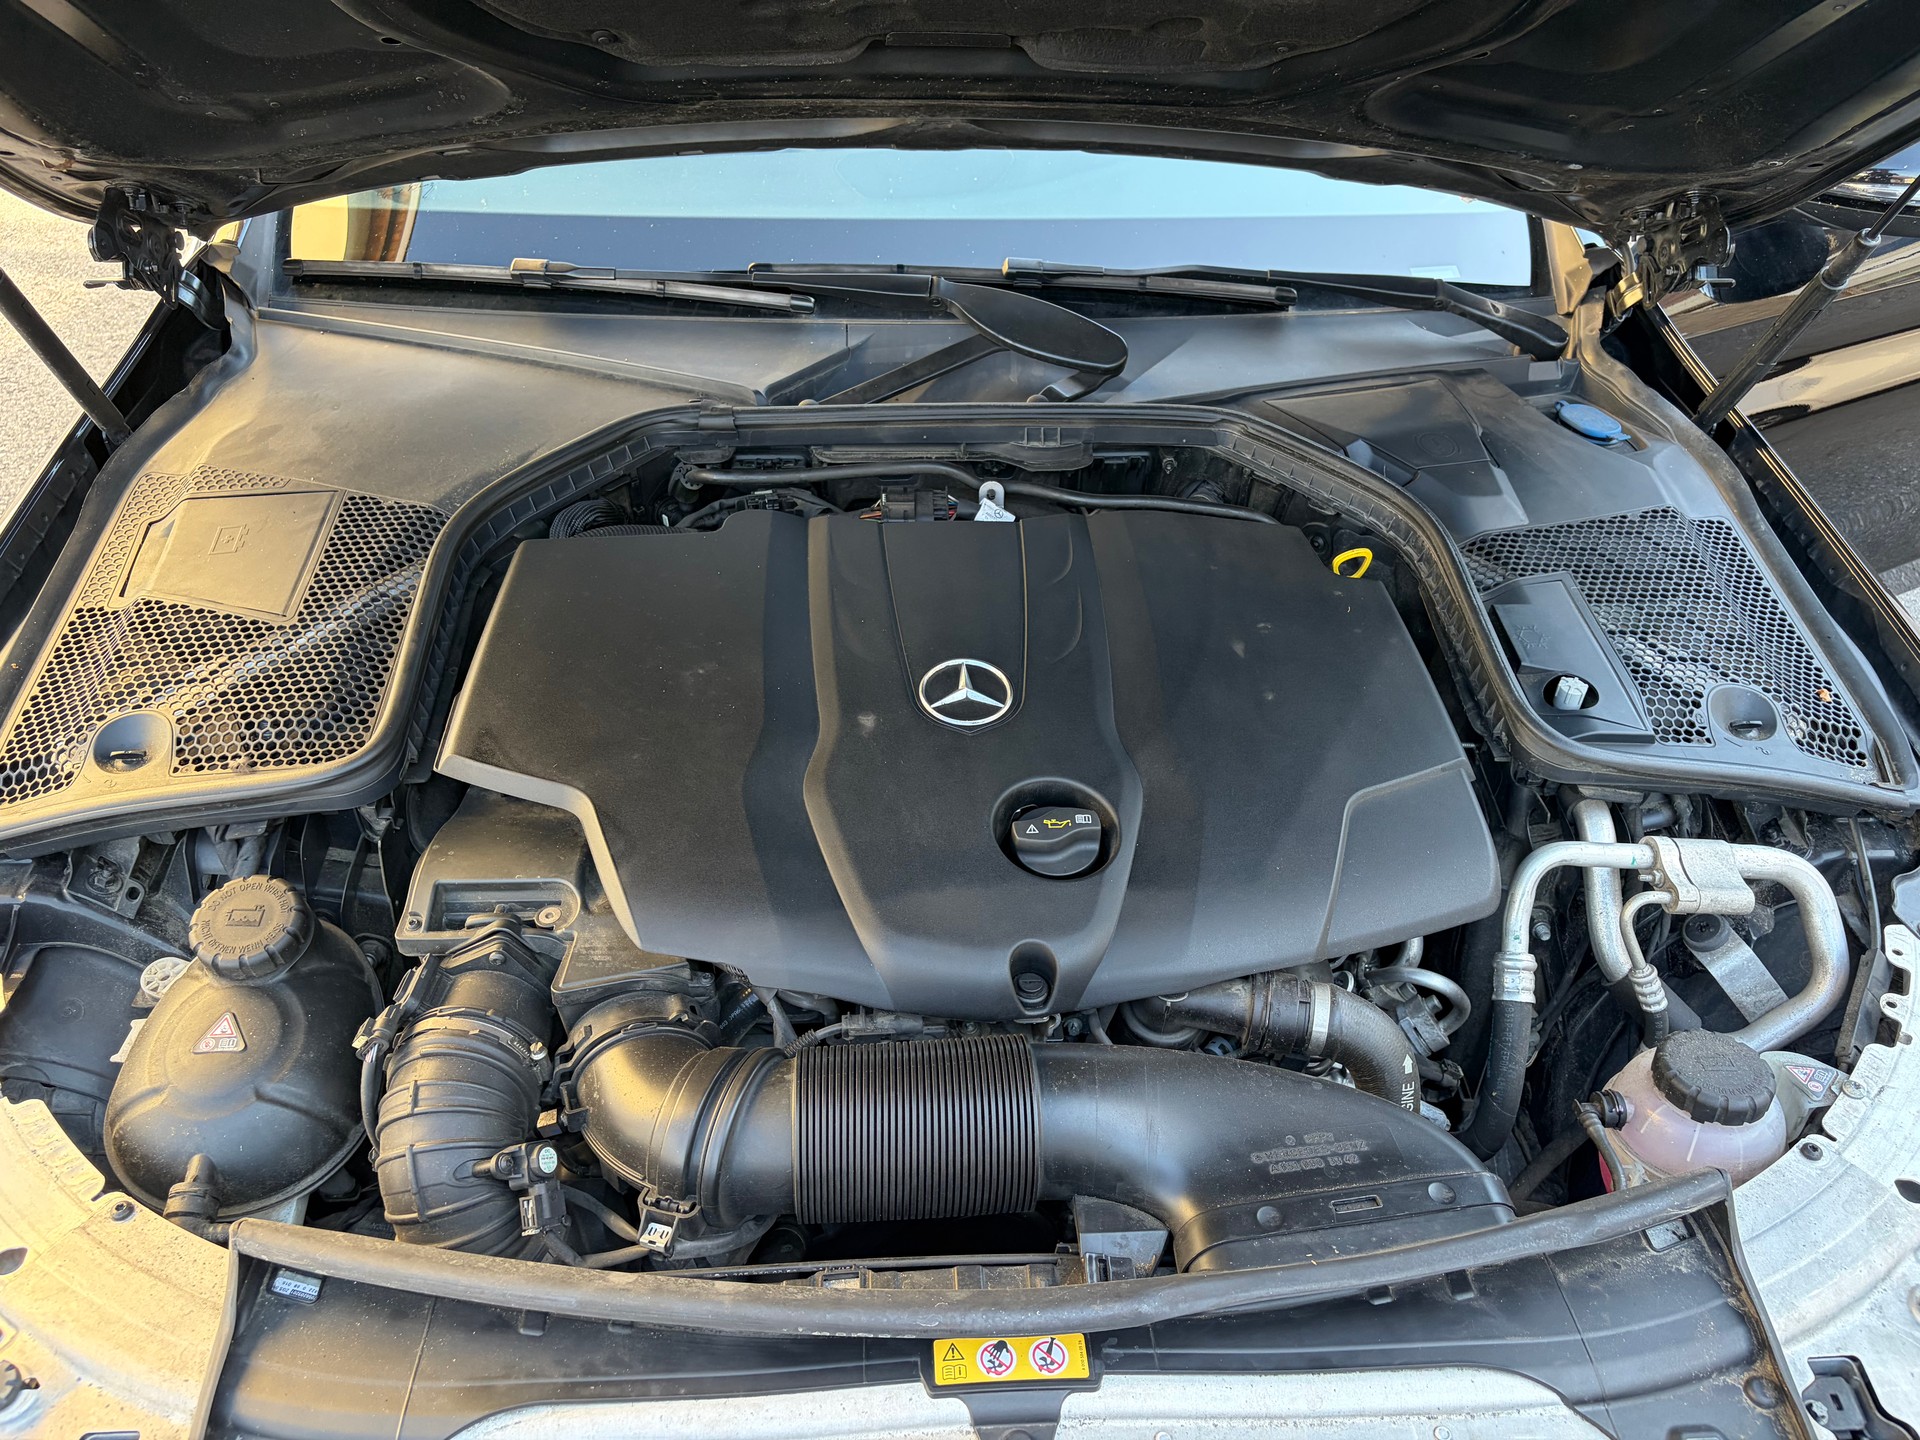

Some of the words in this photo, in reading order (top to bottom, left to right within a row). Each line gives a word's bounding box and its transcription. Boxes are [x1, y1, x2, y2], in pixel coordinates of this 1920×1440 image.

[220, 887, 237, 900] NOT
[239, 882, 263, 892] OPEN
[263, 883, 284, 902] WHEN
[279, 899, 292, 914] HOT
[201, 919, 212, 941] NICHT
[239, 940, 264, 954] WENN
[1401, 1081, 1415, 1112] GINE
